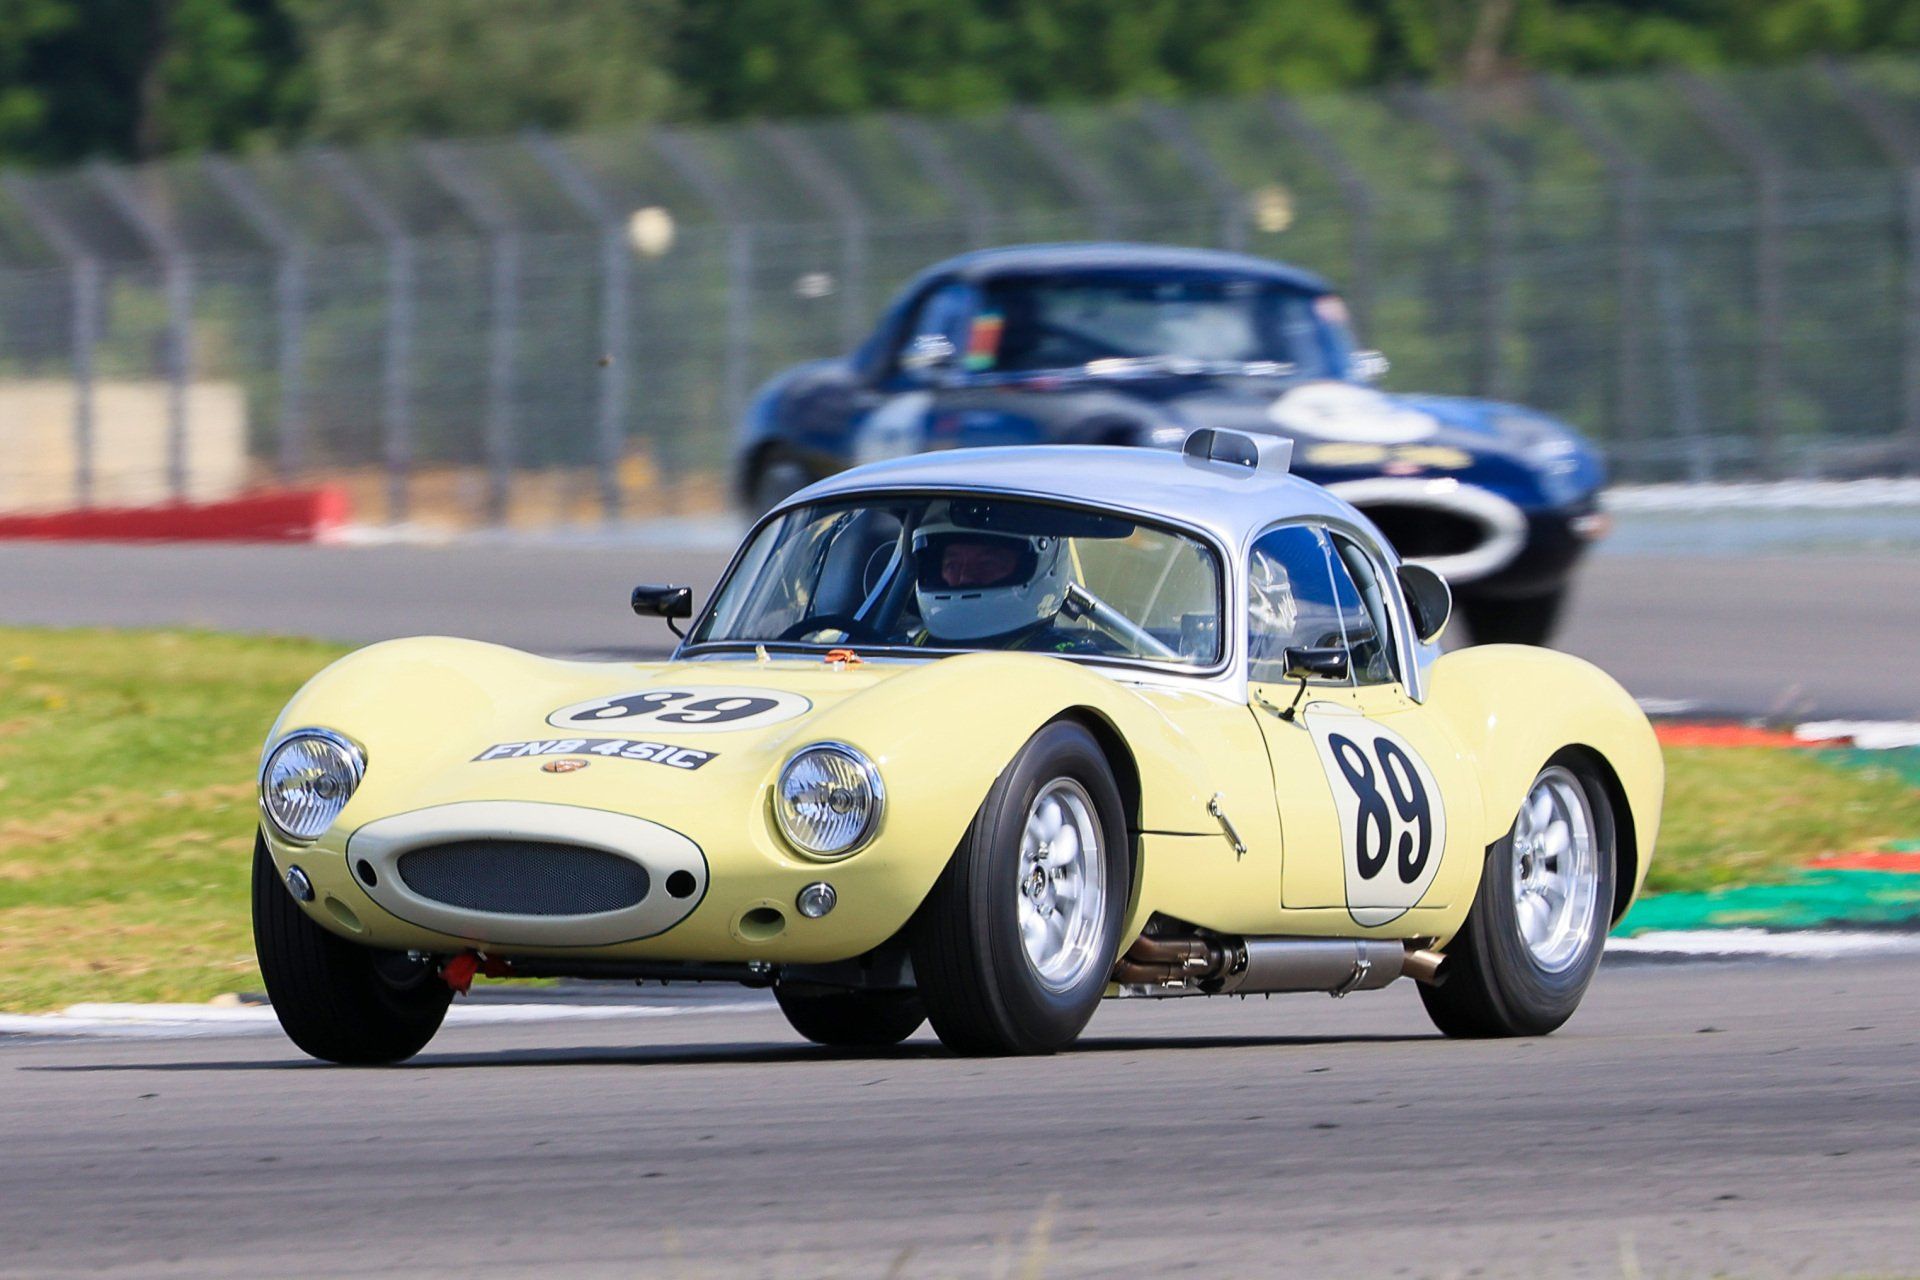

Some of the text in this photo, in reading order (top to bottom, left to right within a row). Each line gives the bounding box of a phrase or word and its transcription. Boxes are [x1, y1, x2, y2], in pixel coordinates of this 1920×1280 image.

[569, 691, 779, 723] 89
[480, 739, 586, 760] FNB
[590, 740, 707, 768] 451C
[1328, 733, 1432, 883] 89
